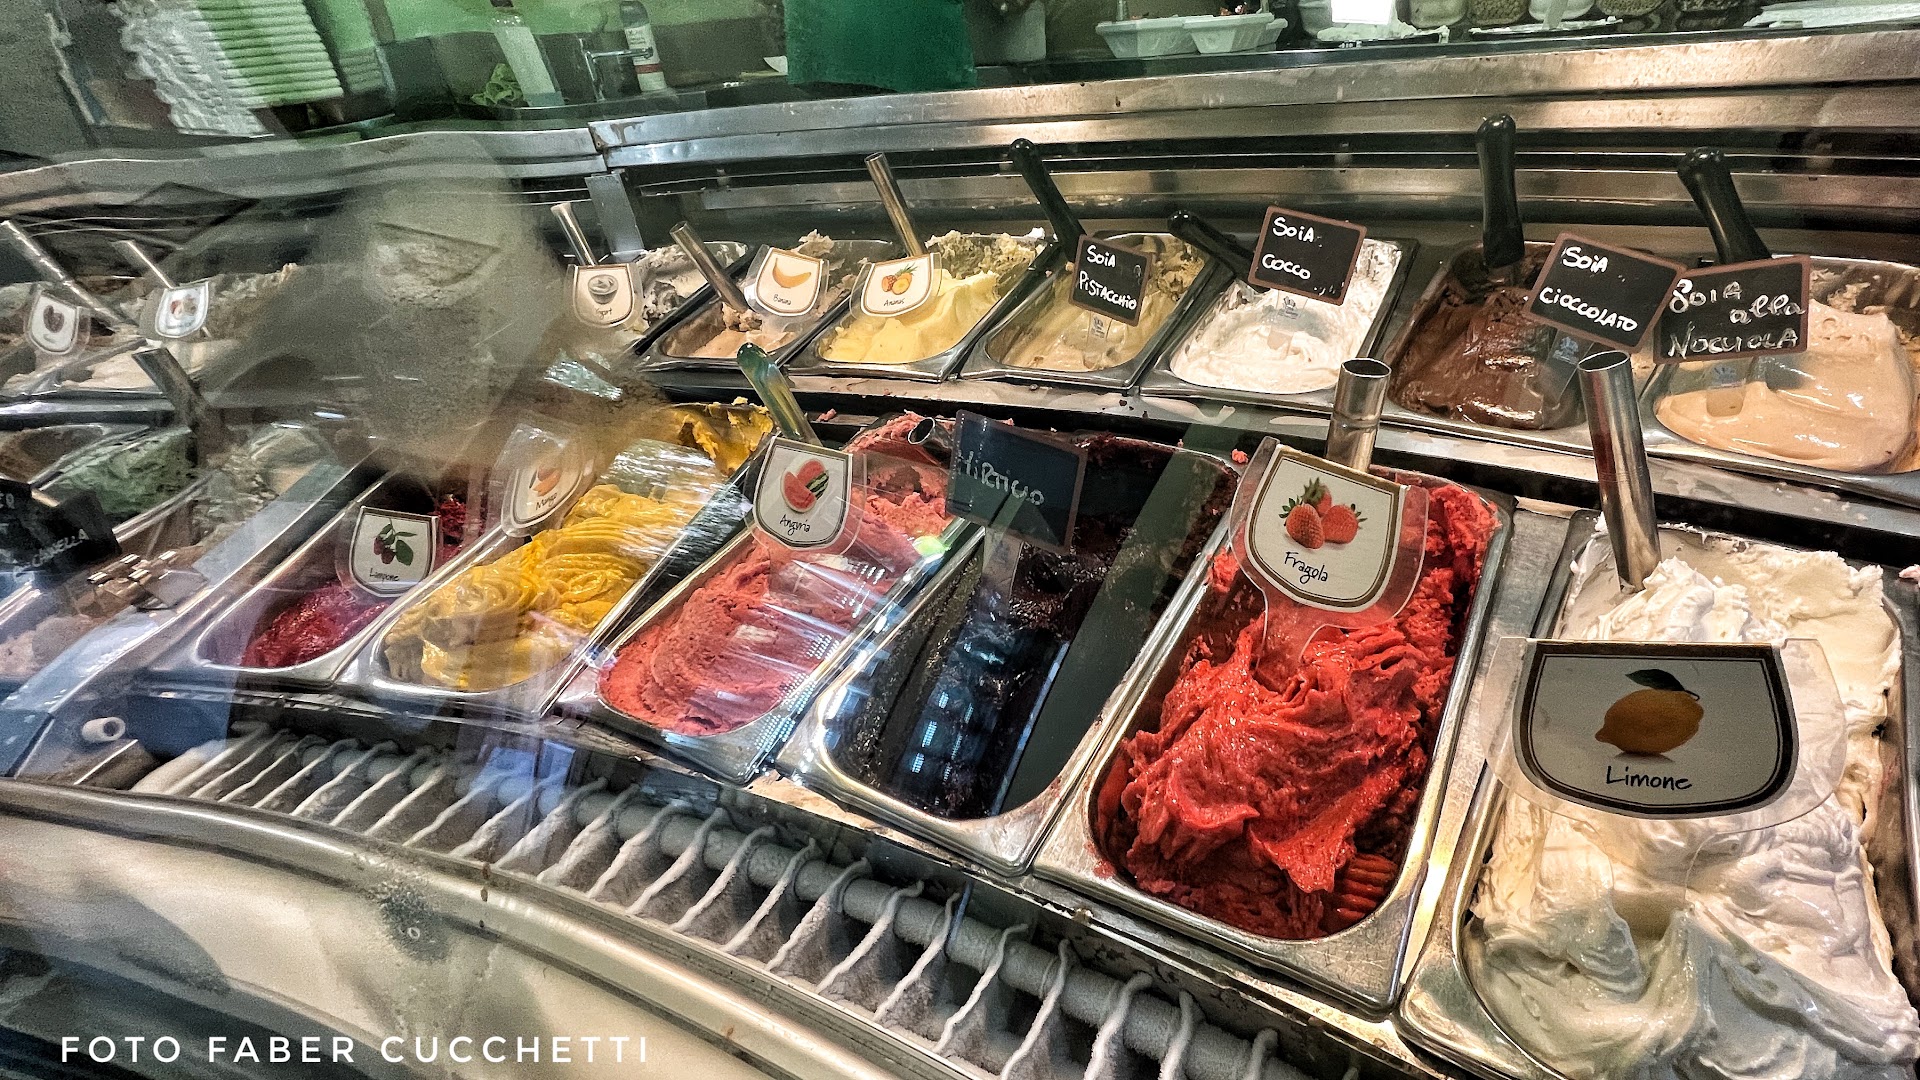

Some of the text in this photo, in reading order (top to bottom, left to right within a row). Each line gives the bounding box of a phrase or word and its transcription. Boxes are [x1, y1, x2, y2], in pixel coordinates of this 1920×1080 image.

[535, 492, 558, 511] Mango
[779, 513, 811, 536] Anguria
[369, 567, 400, 583] Lampone
[1284, 551, 1329, 585] Fragola
[1605, 765, 1693, 791] Limone
